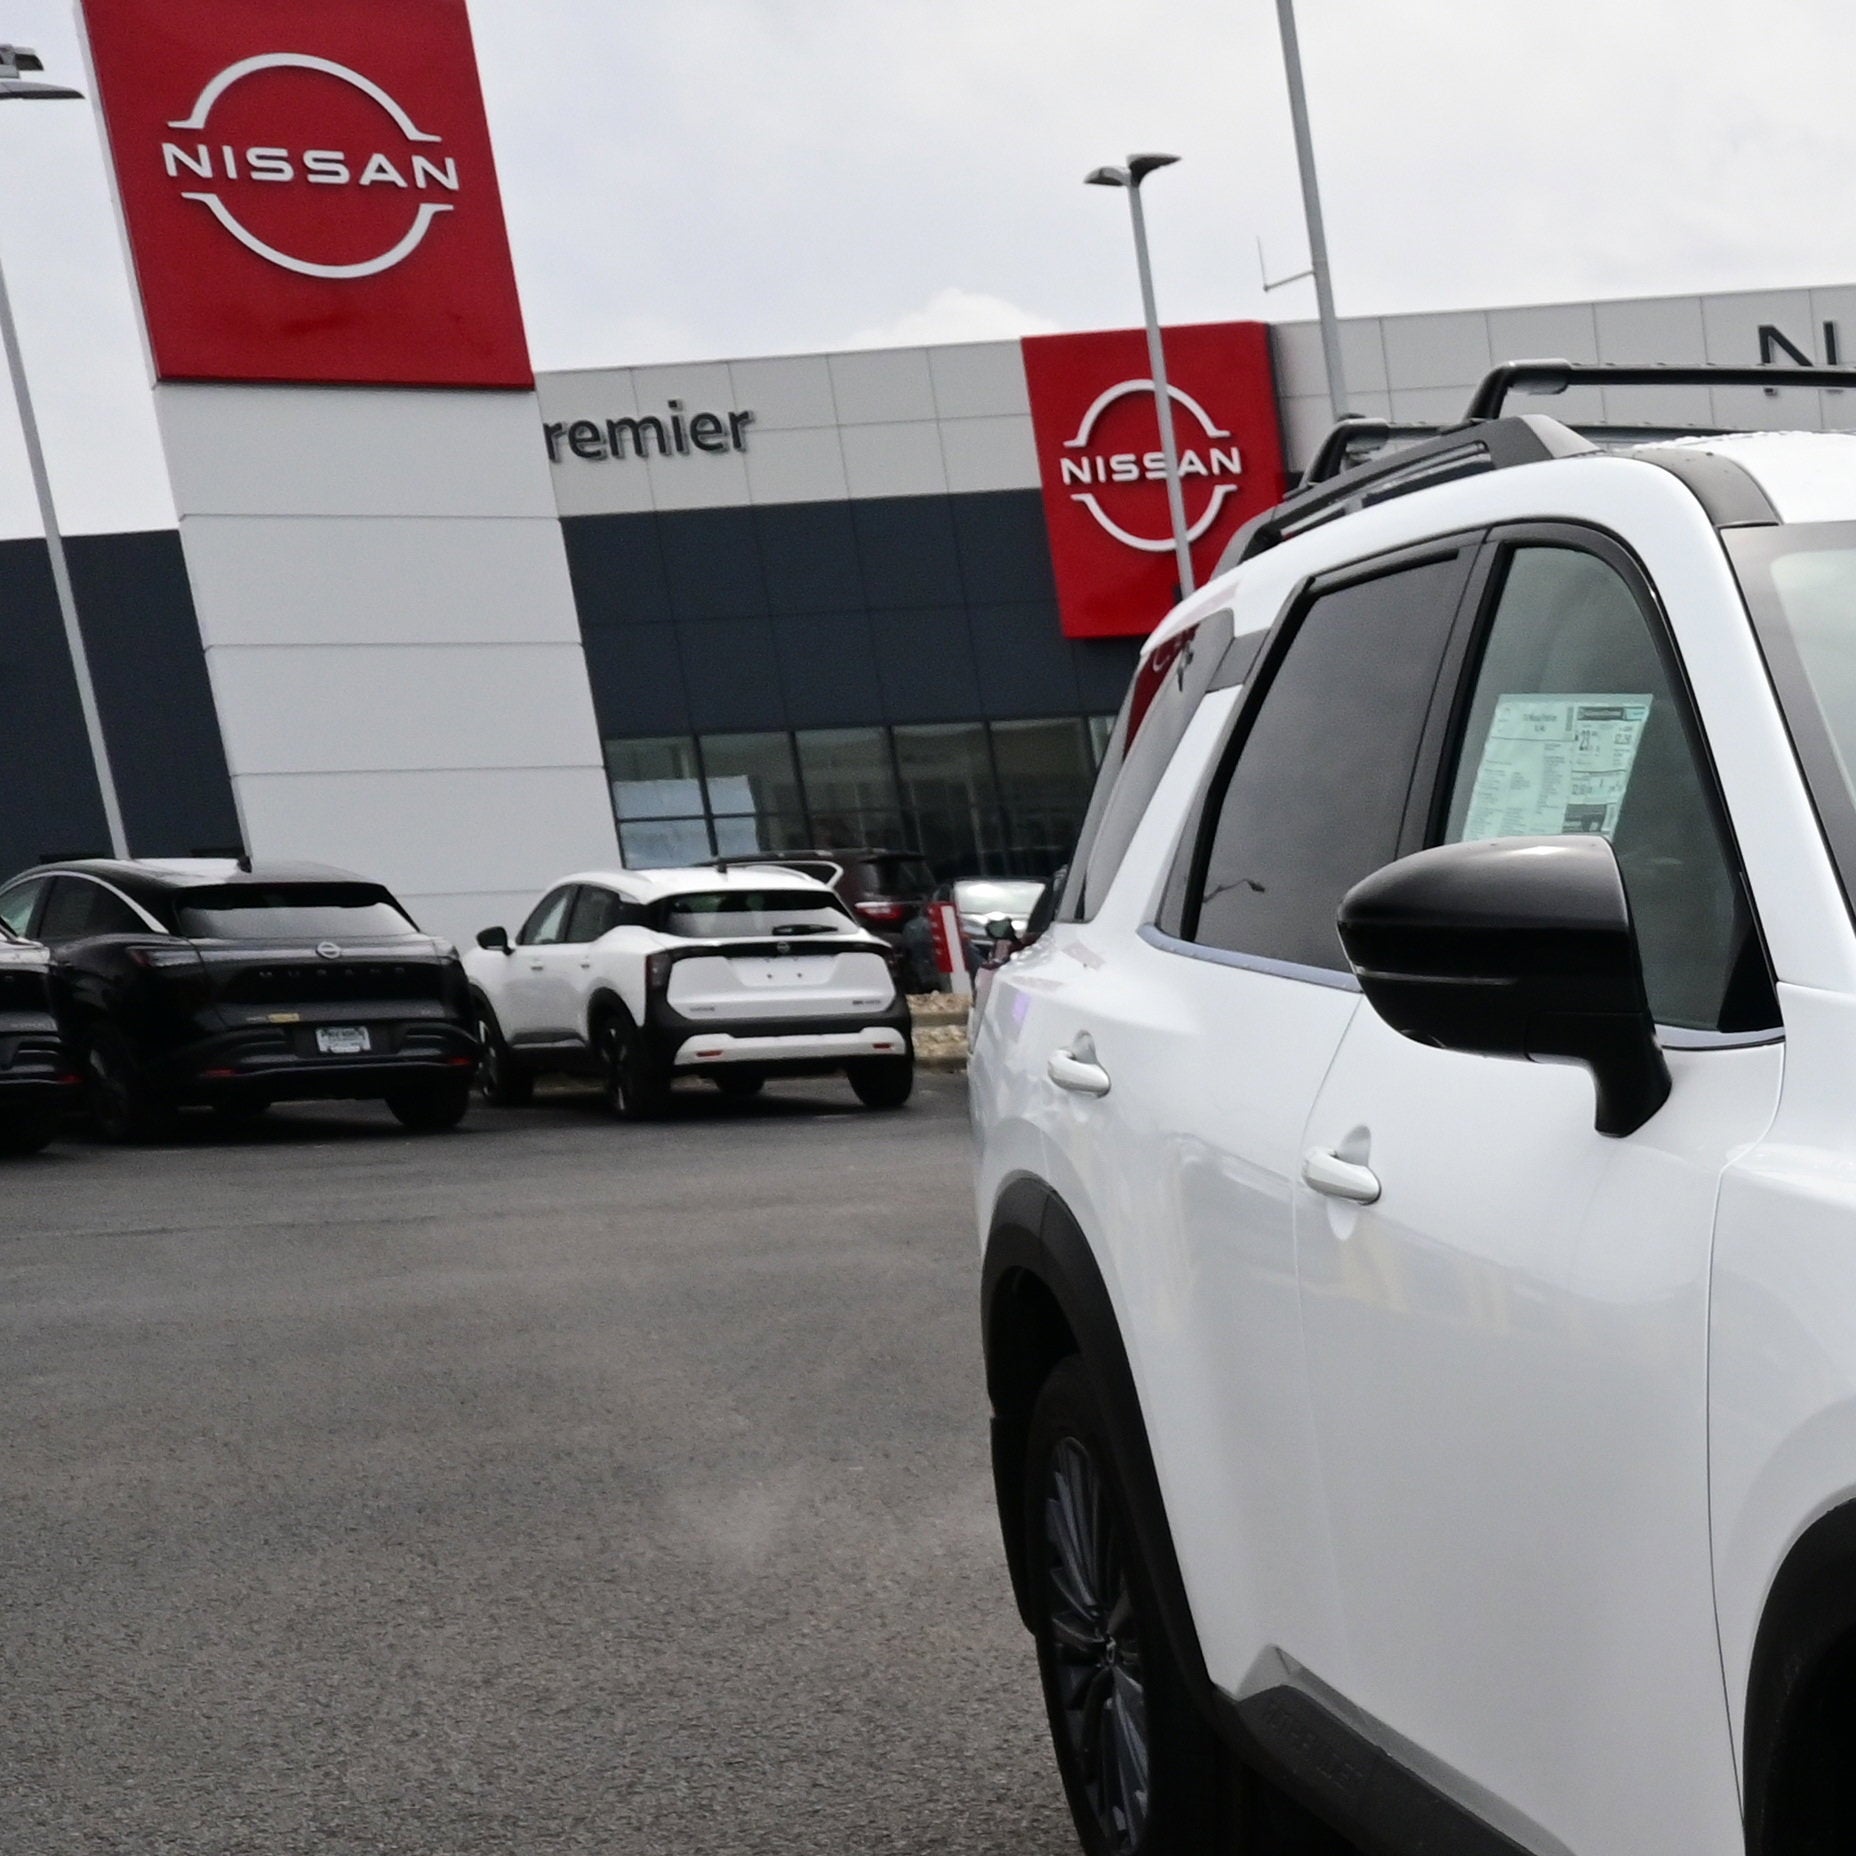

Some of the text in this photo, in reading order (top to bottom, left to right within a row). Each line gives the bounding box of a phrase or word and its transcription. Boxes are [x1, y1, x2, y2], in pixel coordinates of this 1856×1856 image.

[161, 142, 460, 191] NISSAN
[543, 400, 755, 464] remier
[1059, 447, 1242, 487] NISSAN
